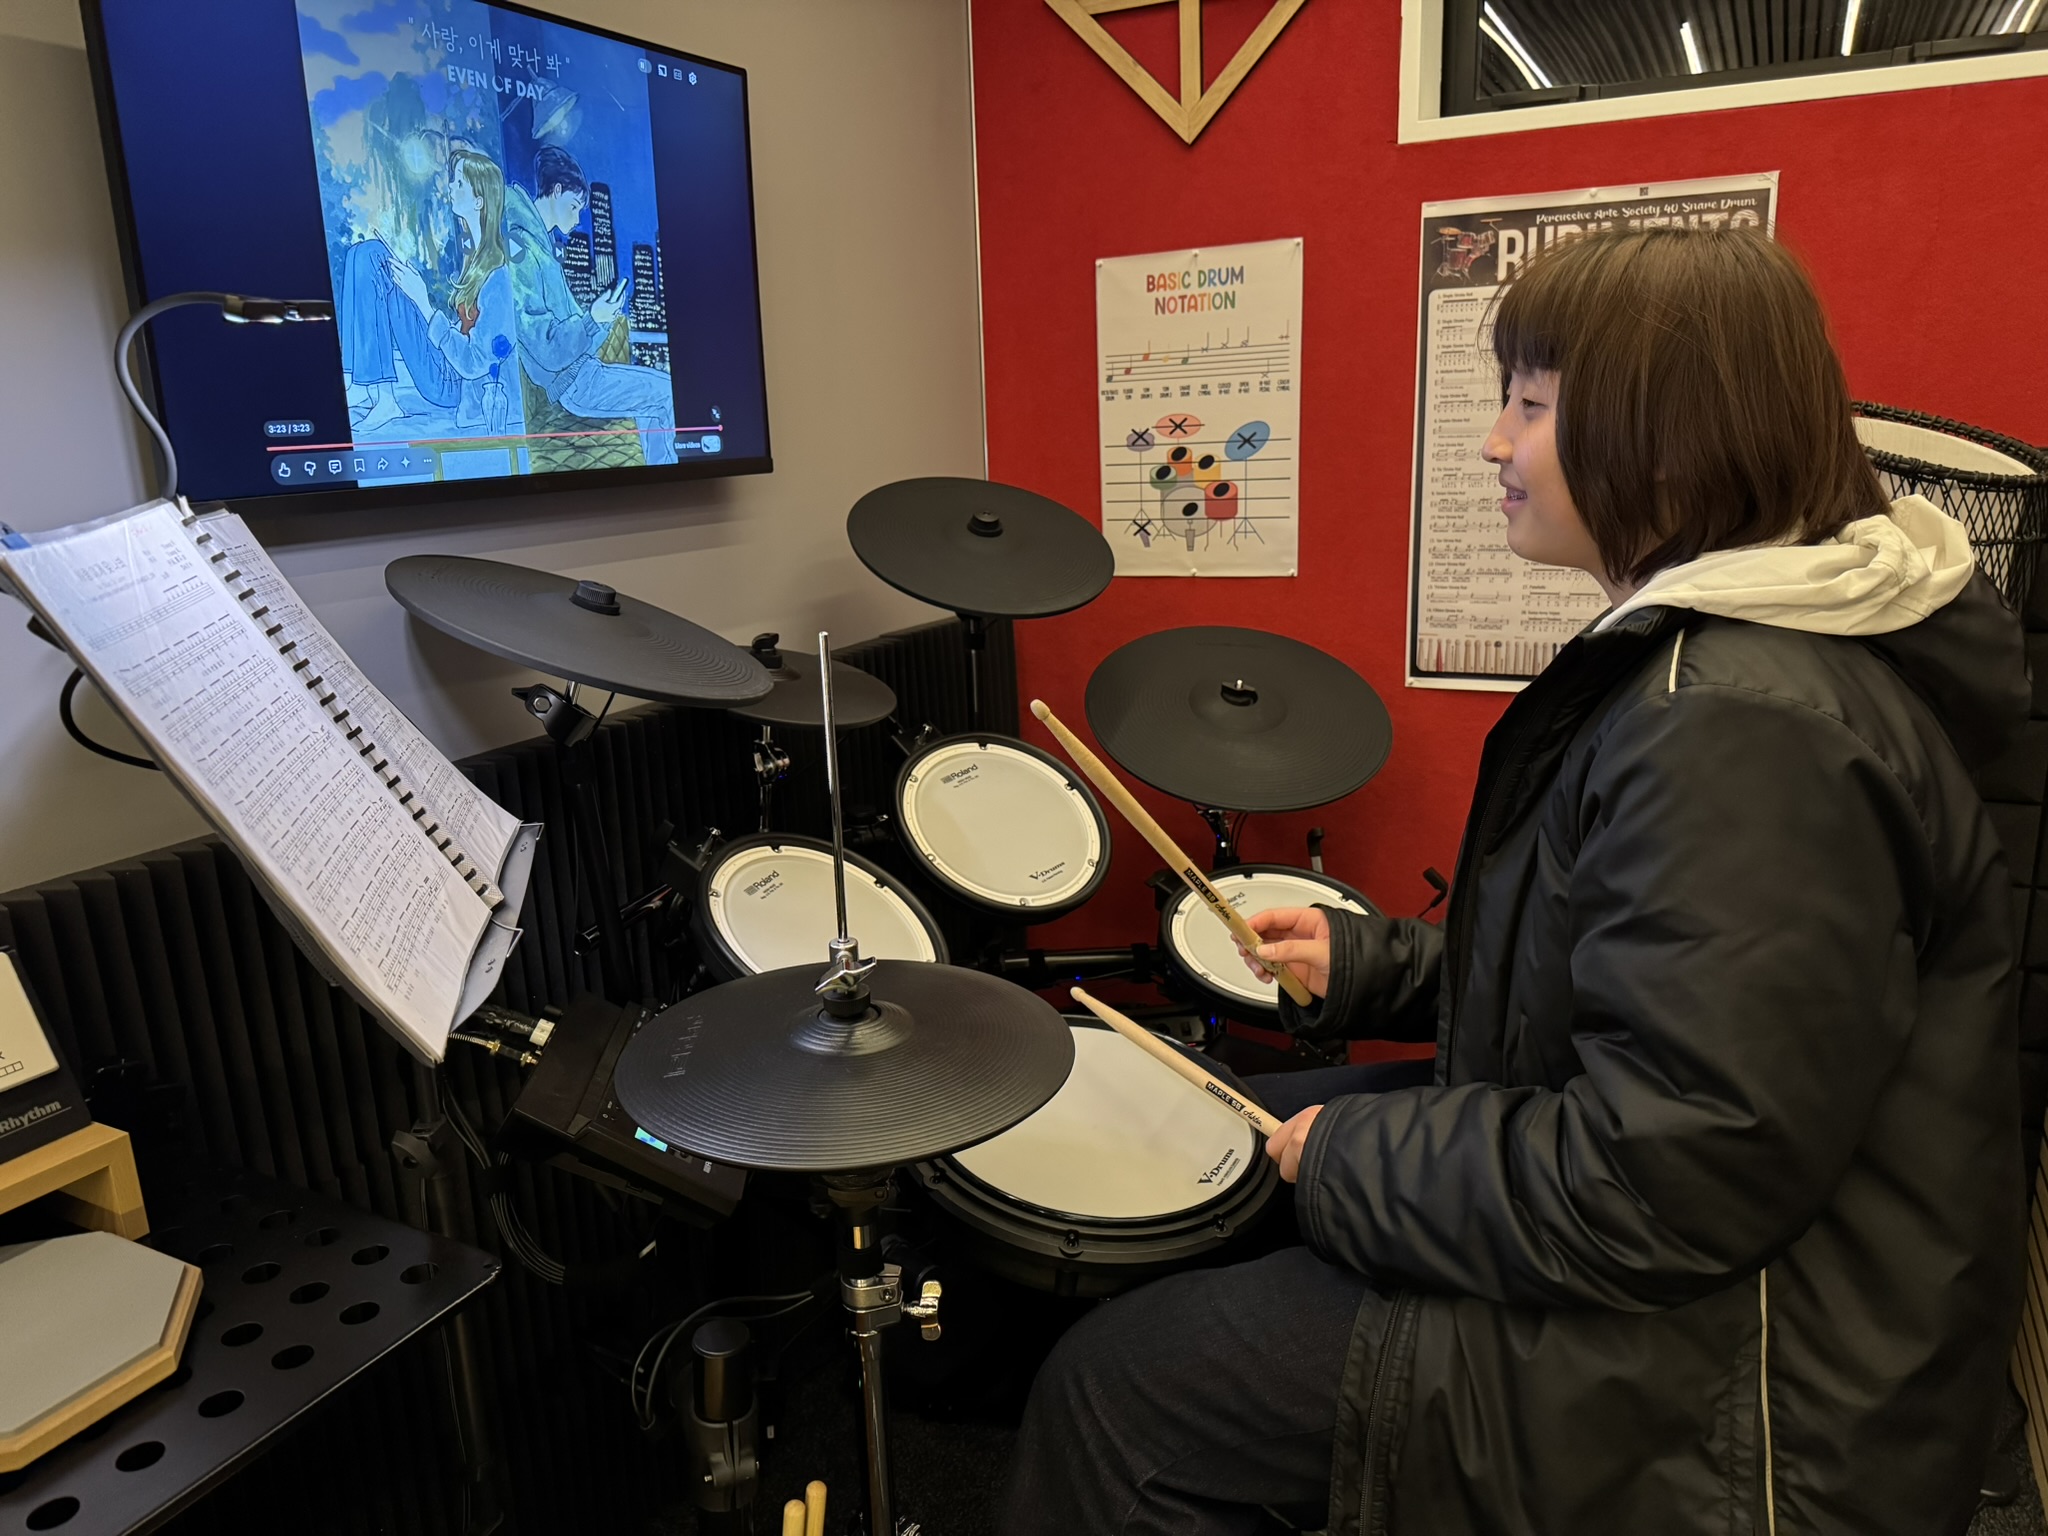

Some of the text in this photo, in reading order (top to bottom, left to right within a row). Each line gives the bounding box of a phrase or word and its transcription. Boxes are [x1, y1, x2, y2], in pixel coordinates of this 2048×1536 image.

[422, 22, 462, 54] 사랑,
[469, 34, 501, 64] 이게
[508, 44, 541, 73] 맞나
[546, 54, 562, 78] 봐
[447, 64, 544, 100] EVEN OF DAY
[1536, 211, 1592, 224] Percussive
[1622, 206, 1660, 217] Society
[1664, 203, 1678, 214] 40
[1682, 201, 1718, 212] Snare
[1720, 198, 1757, 209] Drum
[1146, 266, 1244, 292] BASIC DRUM
[1155, 291, 1236, 315] NOTATION
[268, 425, 286, 433] 3:23
[292, 424, 310, 432] 3:23
[950, 764, 978, 780] Roland
[753, 870, 780, 890] Roland
[1186, 870, 1207, 892] MAPLE
[1227, 892, 1245, 903] land
[1207, 1083, 1242, 1110] MAPLE 5B
[0, 1100, 62, 1132] Rhythm
